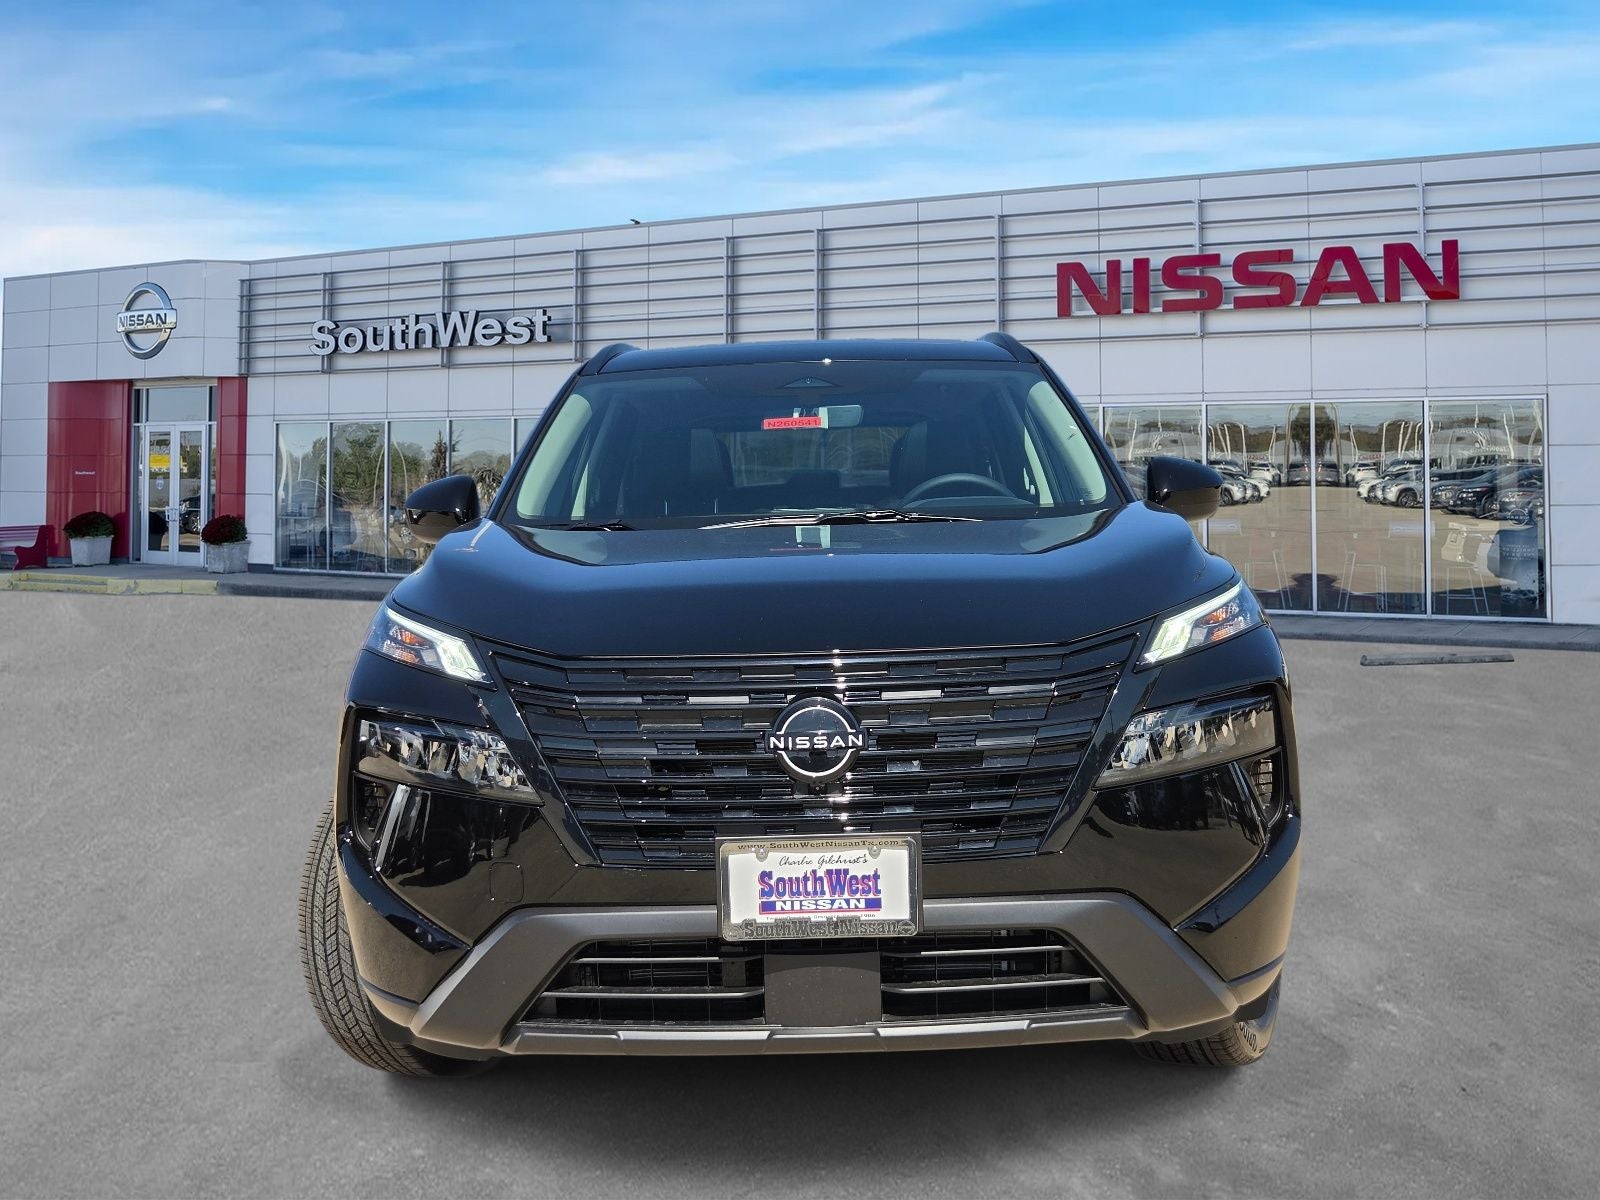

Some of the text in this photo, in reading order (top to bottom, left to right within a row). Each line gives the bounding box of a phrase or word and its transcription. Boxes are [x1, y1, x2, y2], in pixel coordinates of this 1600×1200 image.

[1056, 239, 1461, 318] NISSAN
[119, 312, 167, 328] NISSAN
[308, 308, 551, 356] SouthWest
[767, 419, 820, 428] N260541
[769, 734, 863, 750] NISSAN
[779, 855, 813, 867] Charlie
[758, 867, 882, 899] SouthWest
[775, 898, 866, 911] NISSAN
